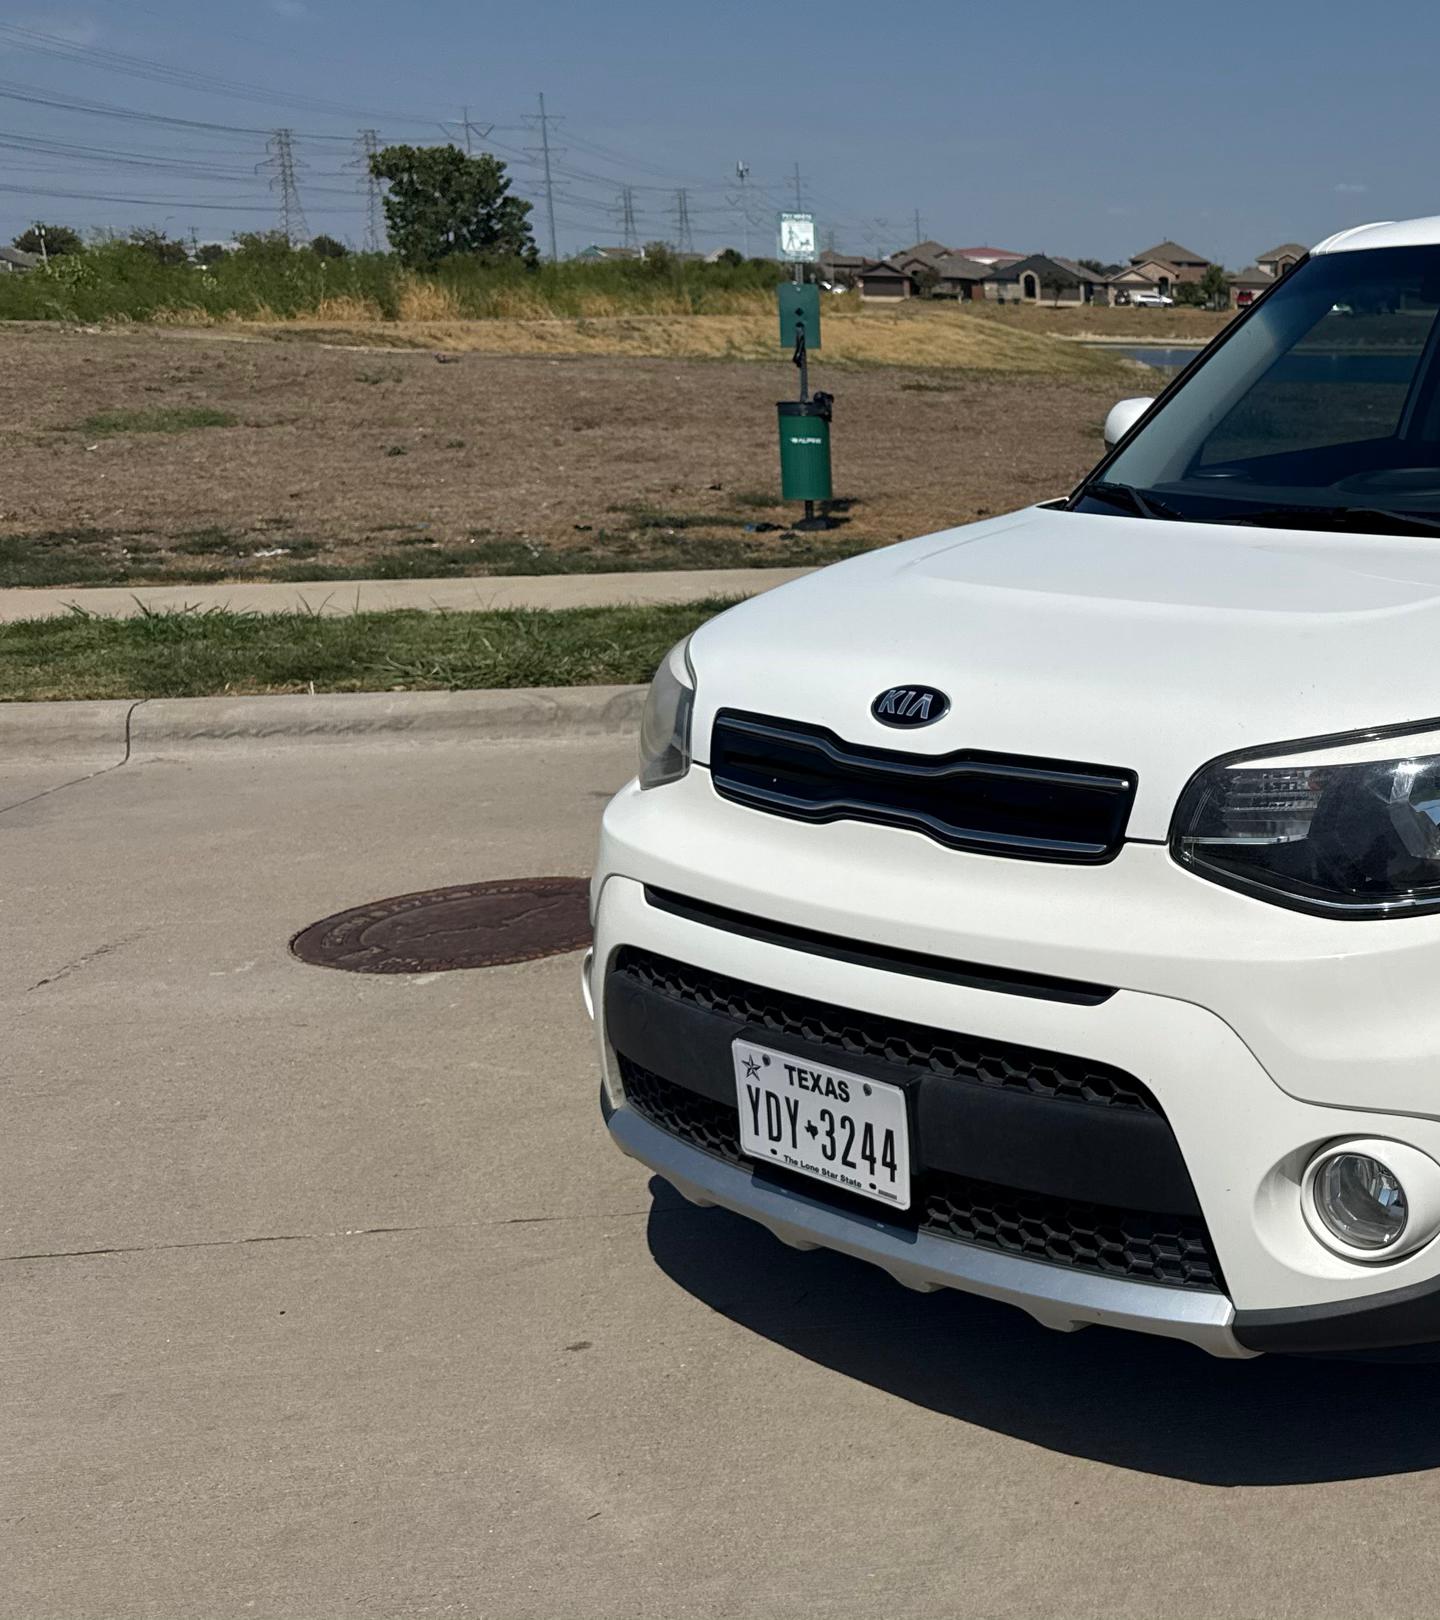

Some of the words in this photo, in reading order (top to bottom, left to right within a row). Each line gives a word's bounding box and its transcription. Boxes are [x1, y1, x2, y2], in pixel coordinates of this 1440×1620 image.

[878, 689, 934, 720] KIA
[783, 1063, 851, 1103] TEXAS
[746, 1083, 800, 1149] YDY
[819, 1108, 898, 1183] 3244
[783, 1154, 799, 1166] The
[800, 1160, 820, 1173] Lone
[821, 1167, 839, 1180] Star
[840, 1174, 862, 1188] State
